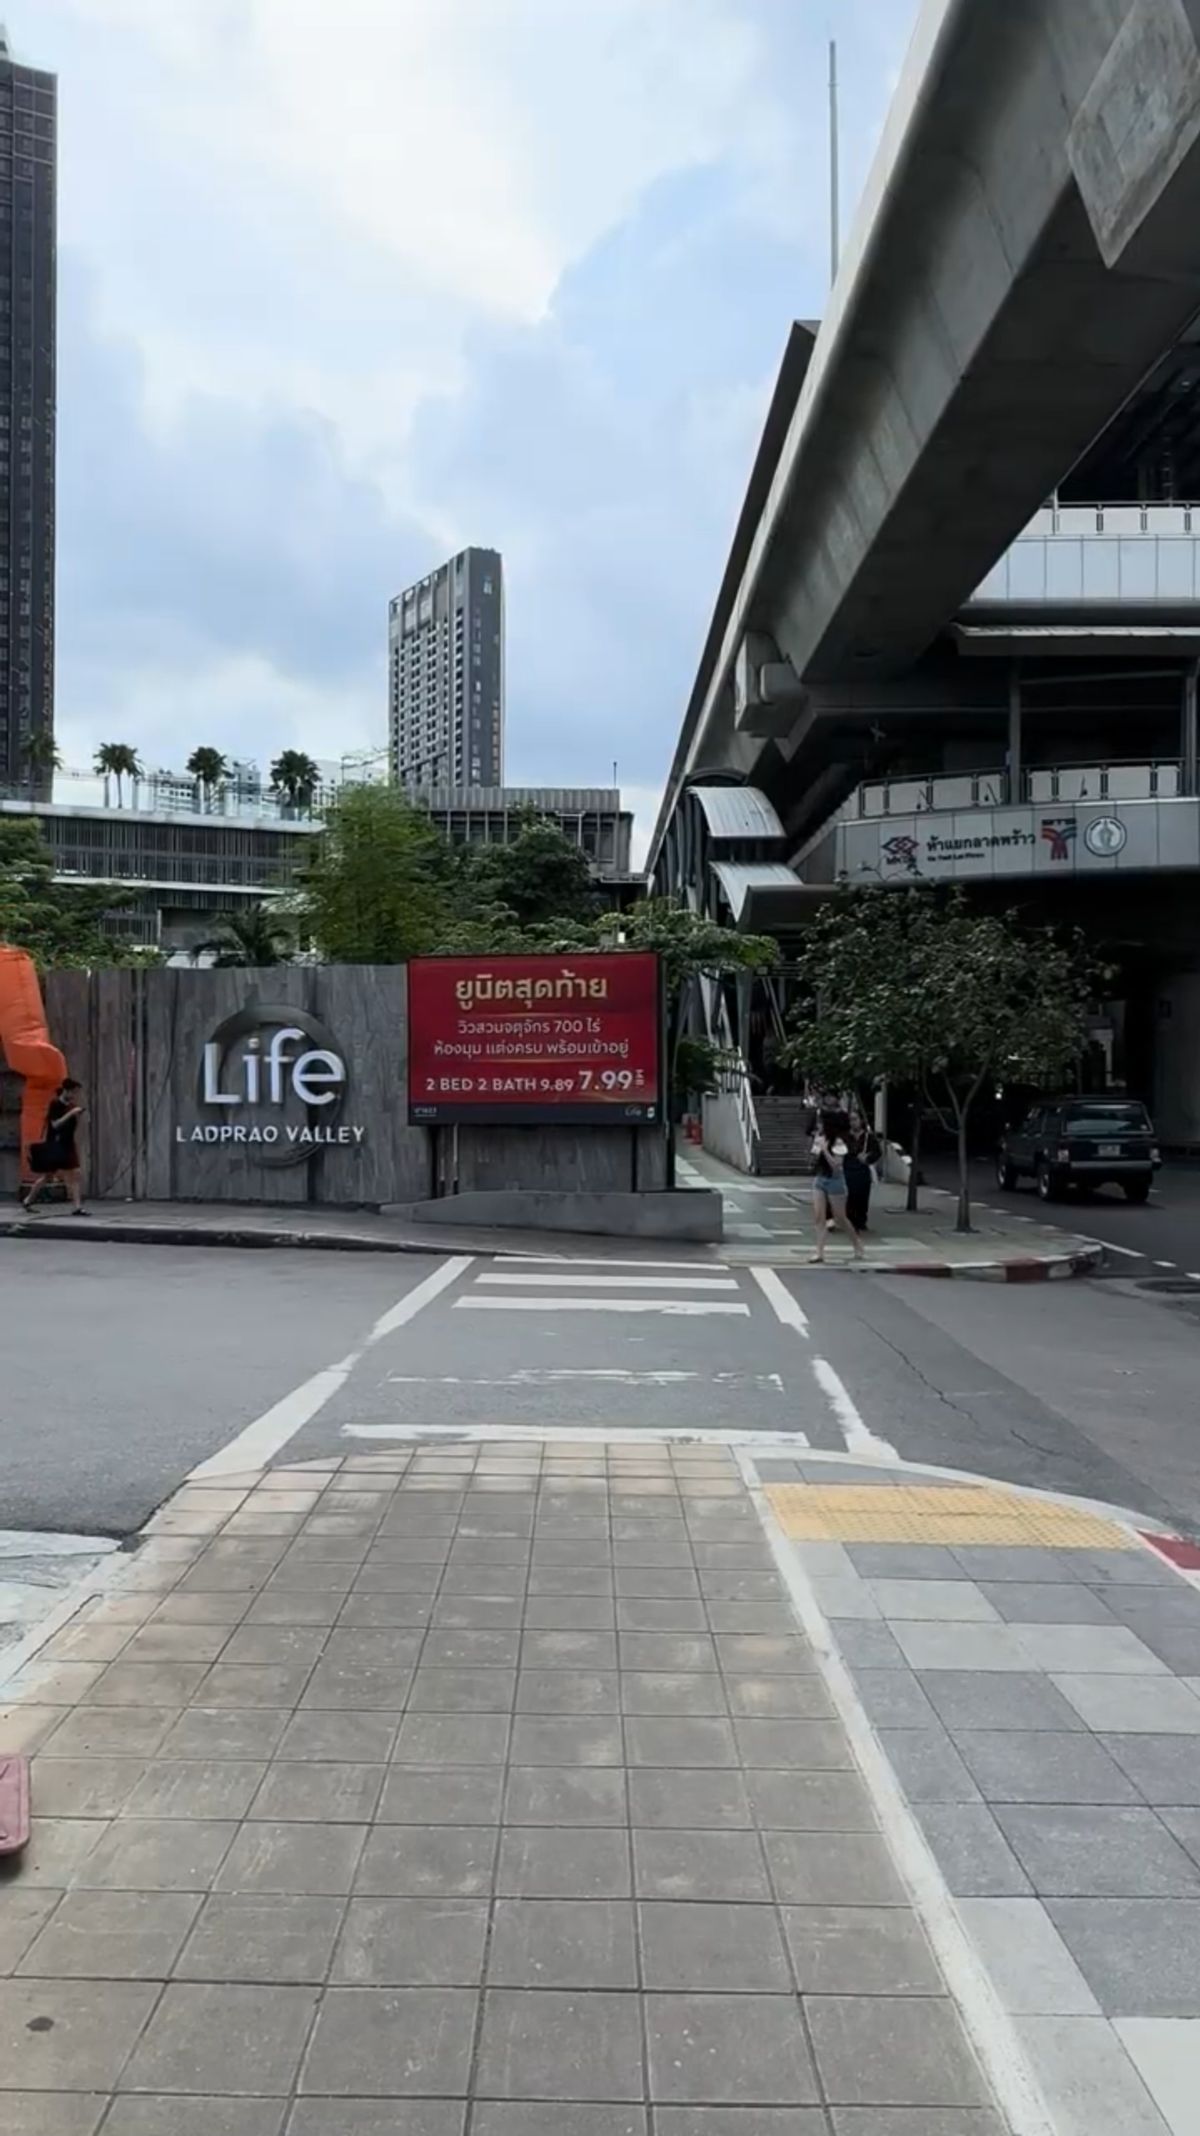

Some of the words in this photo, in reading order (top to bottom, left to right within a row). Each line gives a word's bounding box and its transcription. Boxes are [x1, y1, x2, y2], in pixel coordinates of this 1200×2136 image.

[456, 969, 607, 1010] ยูนิตสุดท้าย
[458, 1019, 550, 1038] วิวสวนจตุจักร
[554, 1020, 583, 1033] 700
[587, 1017, 601, 1033] ไร่
[434, 1040, 482, 1059] ห้องมุม
[486, 1039, 543, 1055] แต่งครบ
[547, 1038, 629, 1059] พร้อมเข้าอยู่
[203, 1028, 346, 1105] Life
[426, 1078, 435, 1091] 2
[440, 1078, 473, 1091] BED
[478, 1078, 487, 1091] 2
[493, 1078, 537, 1091] BATH
[540, 1078, 574, 1091] 9.89
[578, 1070, 633, 1090] 7.99
[285, 1125, 366, 1143] VALLEY
